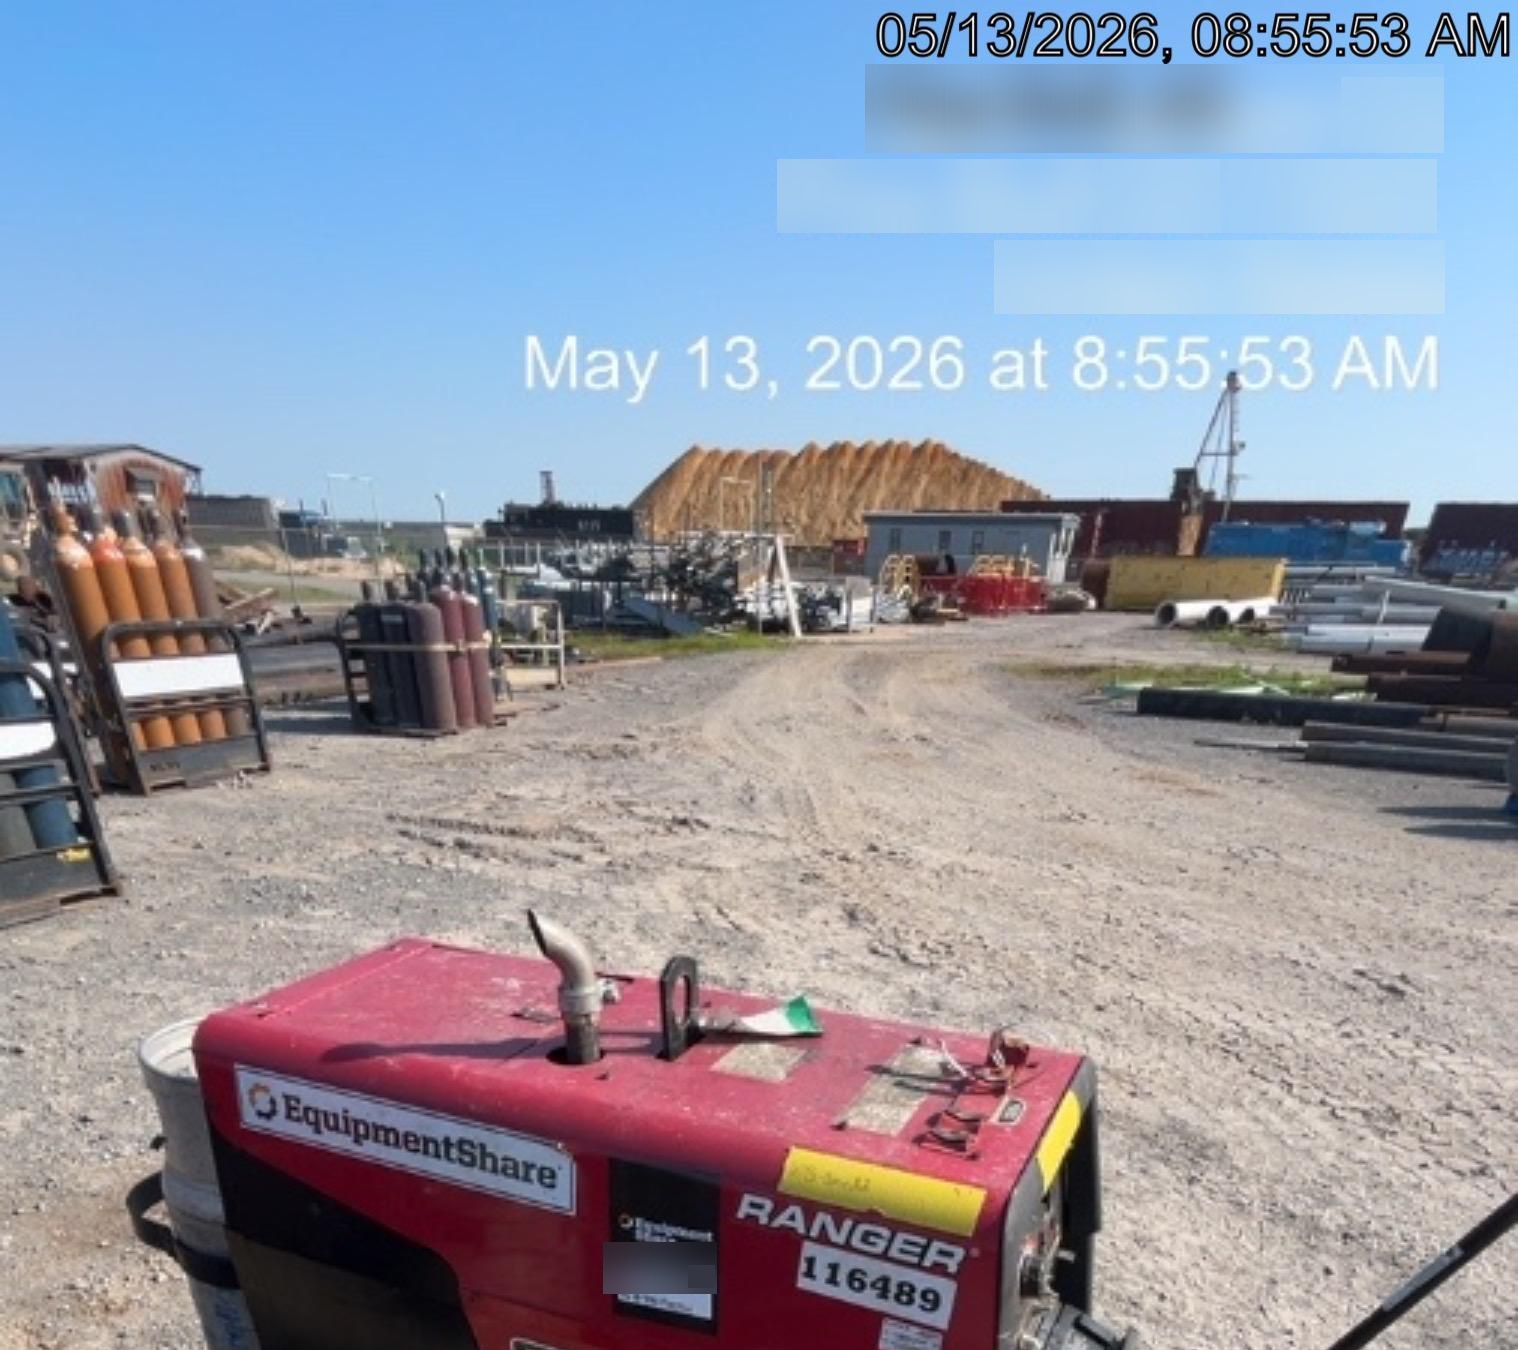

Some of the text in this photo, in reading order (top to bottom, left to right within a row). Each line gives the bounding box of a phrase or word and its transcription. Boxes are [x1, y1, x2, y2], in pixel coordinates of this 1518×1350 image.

[281, 1093, 558, 1189] EquipmentShare
[737, 1192, 967, 1274] RANGER
[801, 1255, 942, 1313] 116489
